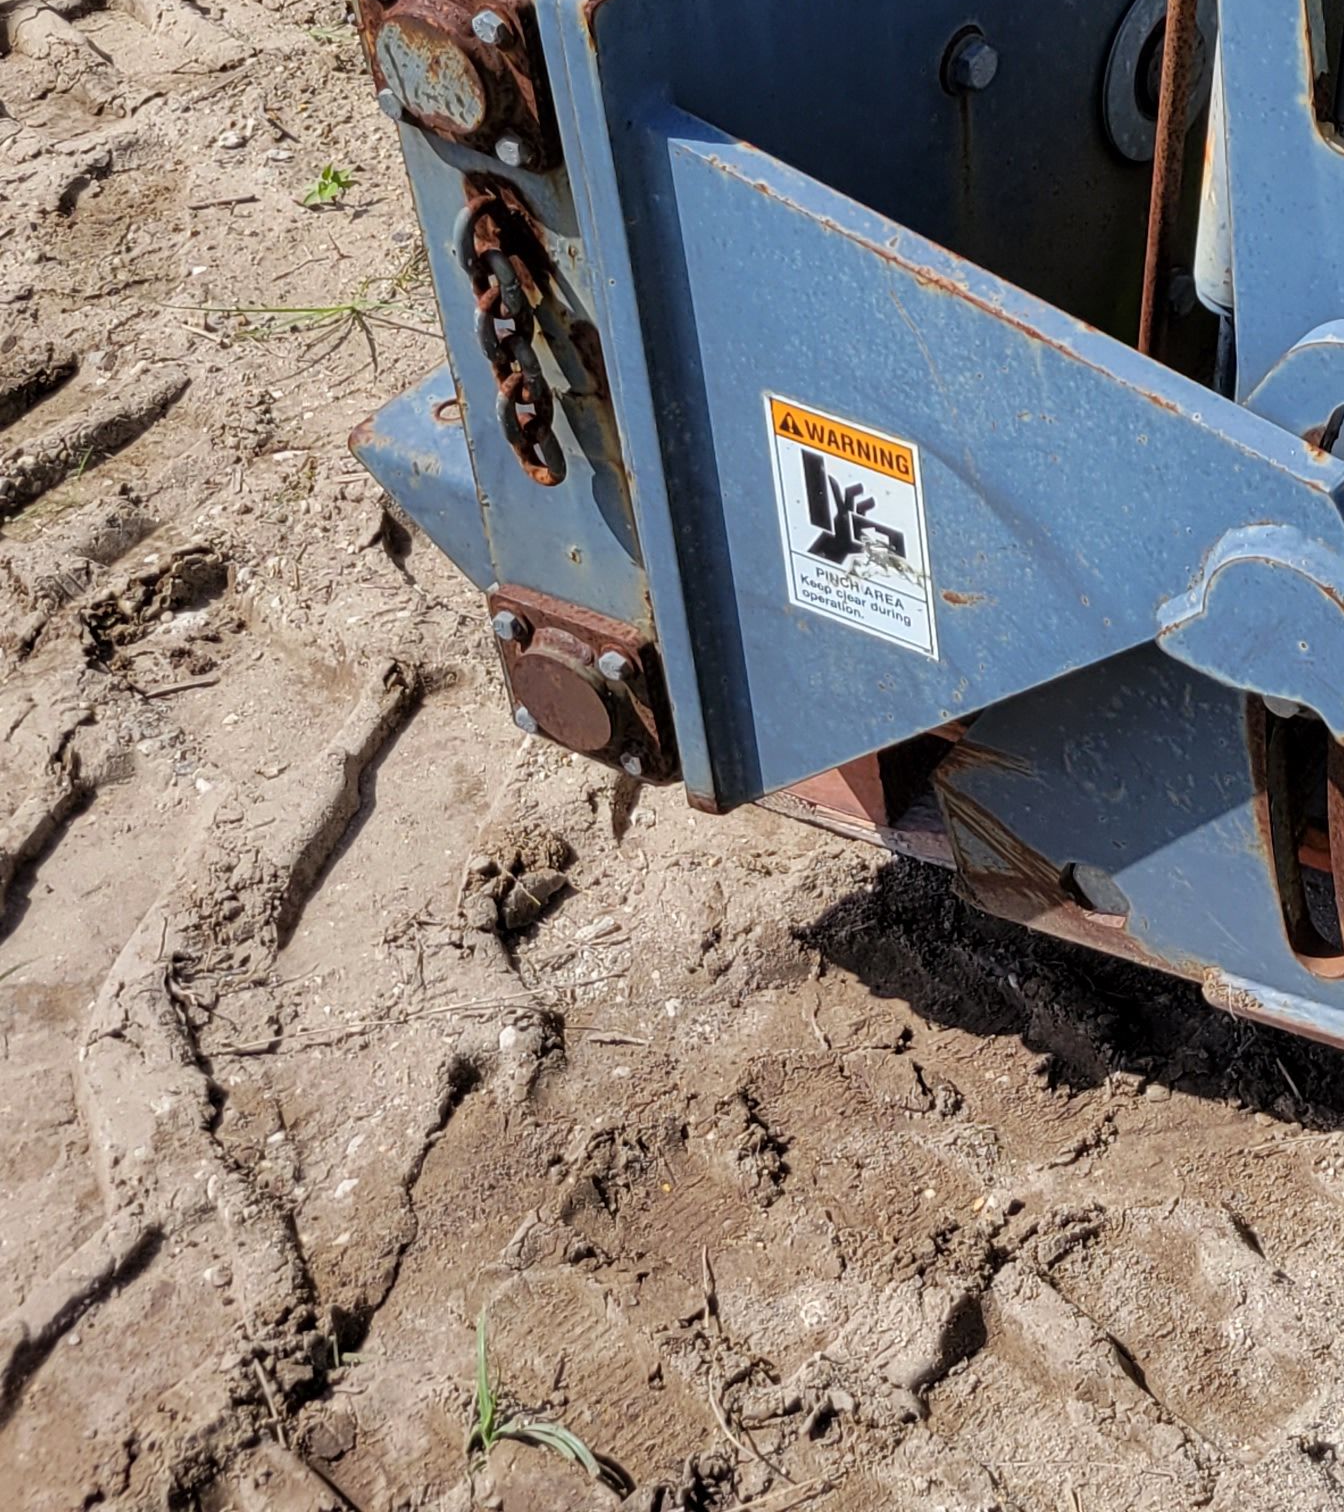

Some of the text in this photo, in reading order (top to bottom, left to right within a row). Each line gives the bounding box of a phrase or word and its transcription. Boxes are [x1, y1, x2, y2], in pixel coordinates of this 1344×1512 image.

[804, 420, 910, 475] WARNING
[800, 574, 912, 627] Keep clear during
[802, 589, 865, 619] operation.
[816, 567, 905, 610] PINCH AREA
